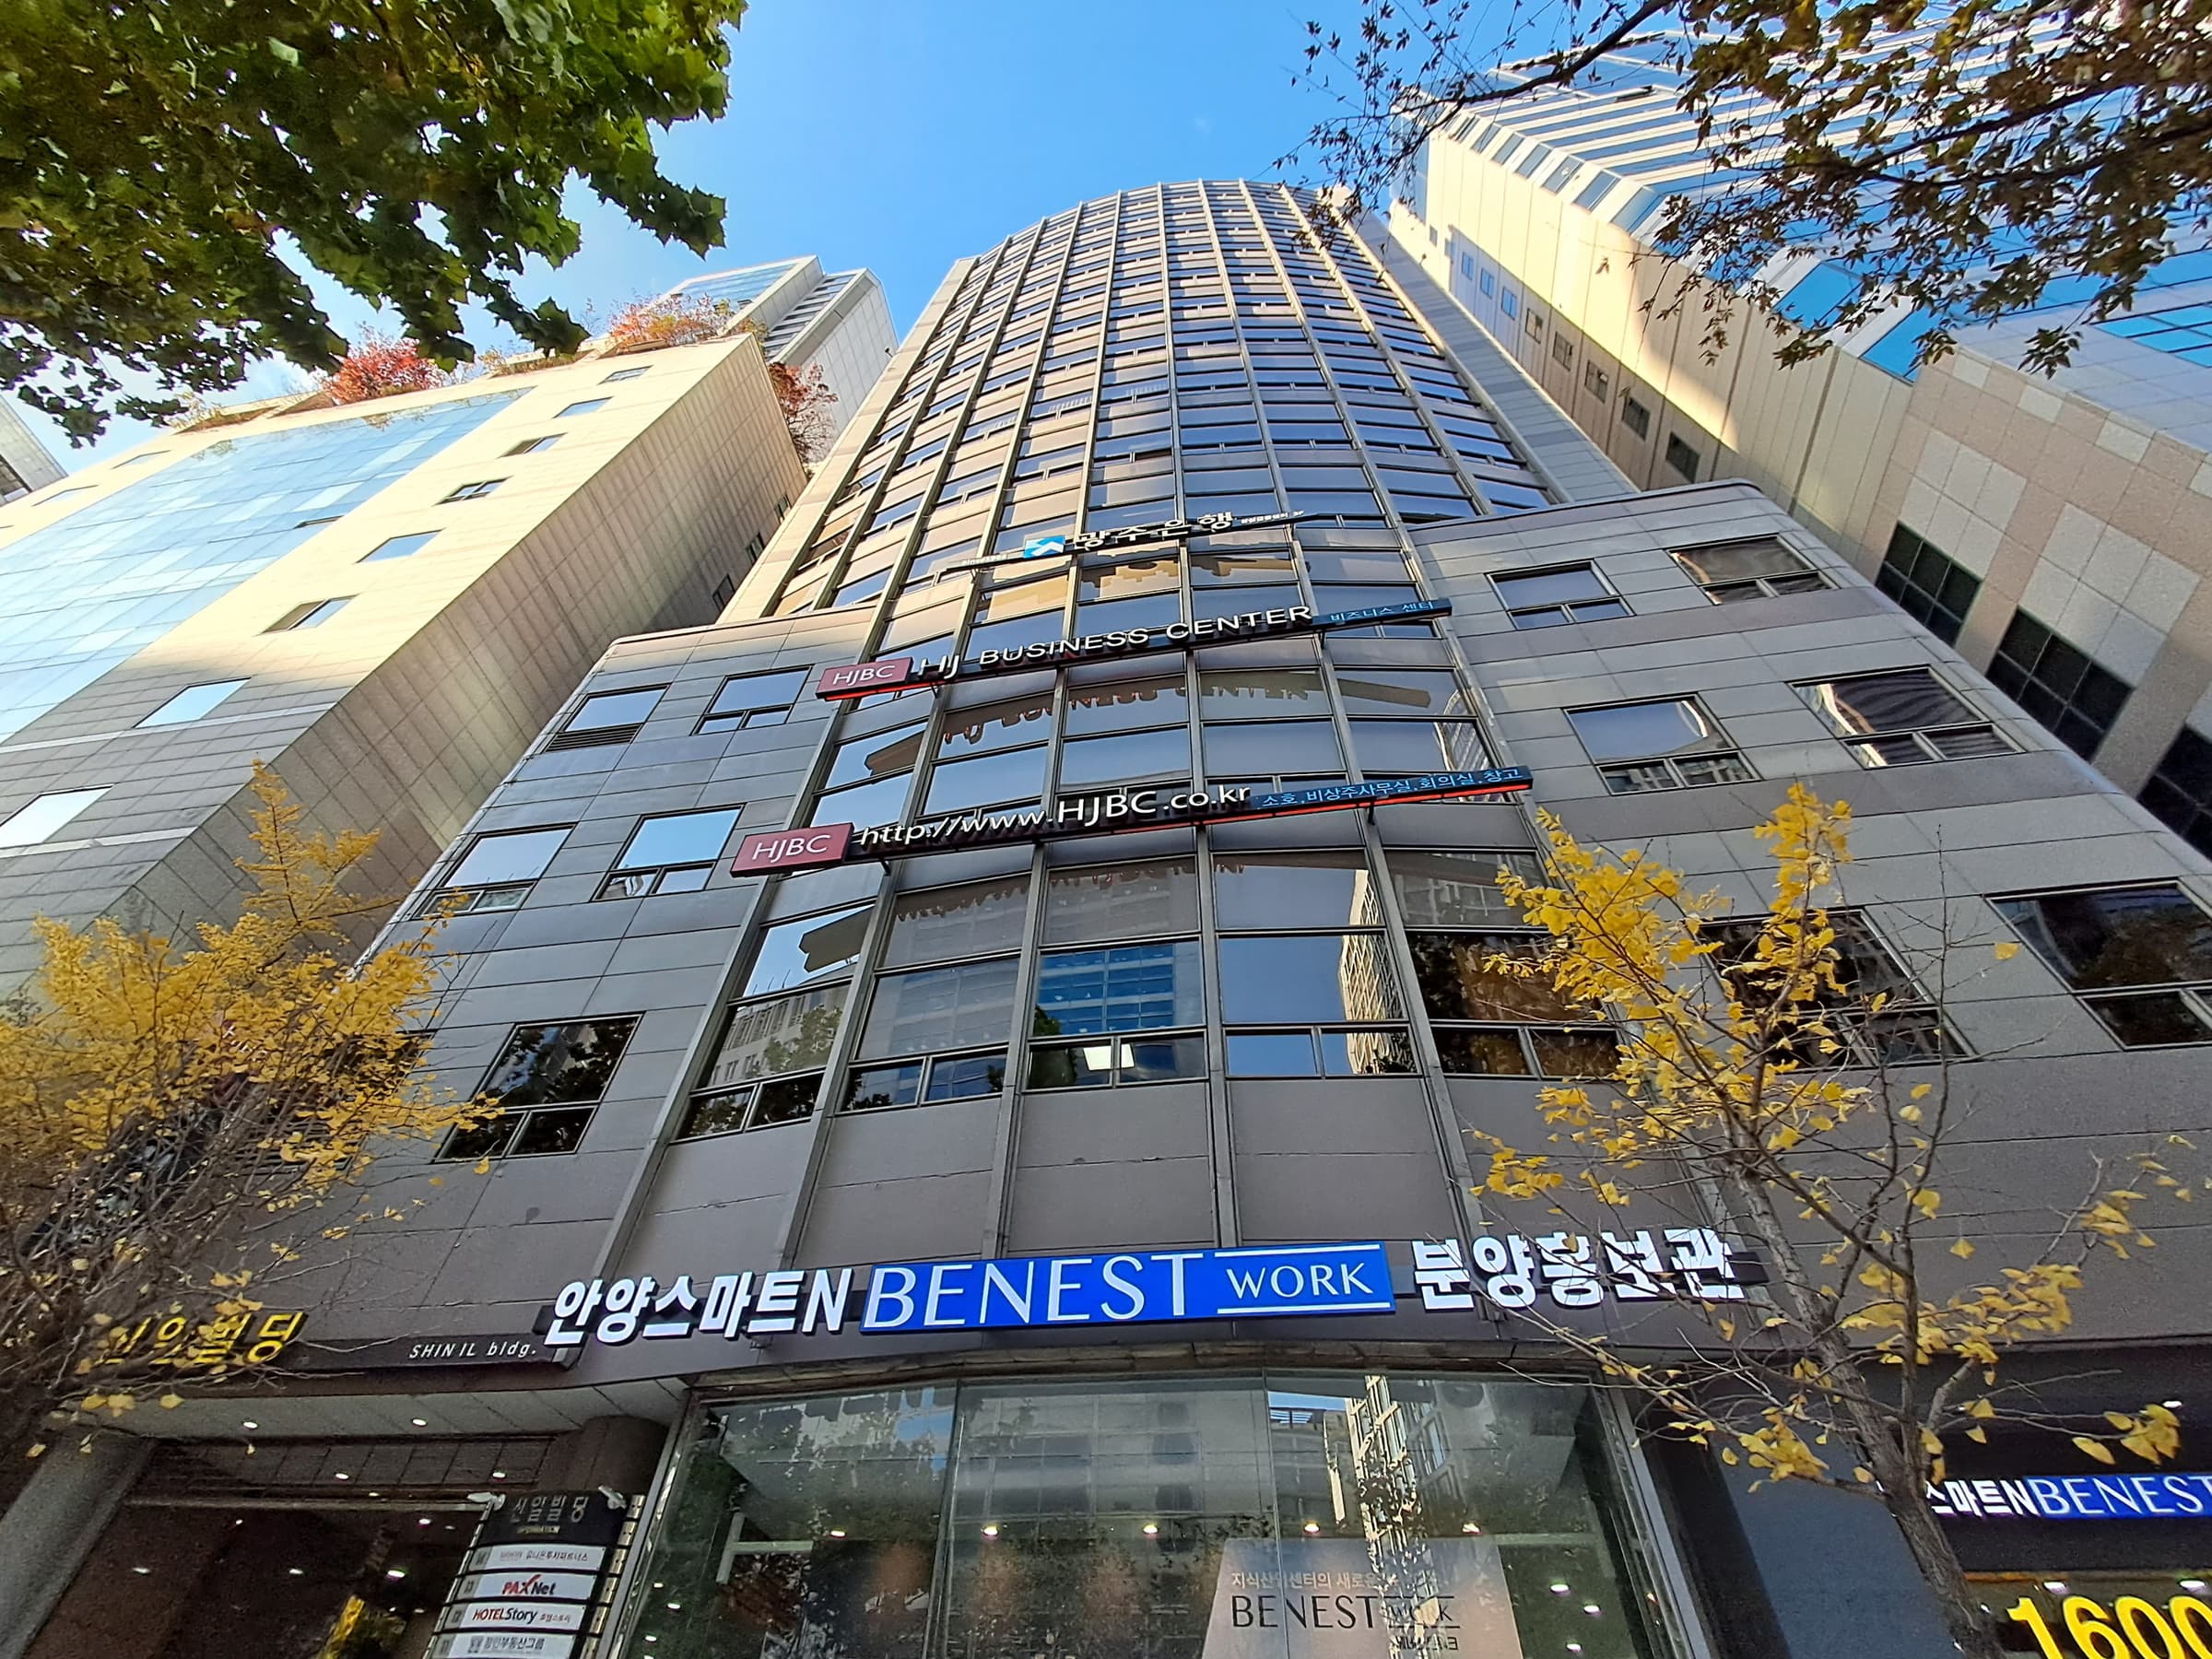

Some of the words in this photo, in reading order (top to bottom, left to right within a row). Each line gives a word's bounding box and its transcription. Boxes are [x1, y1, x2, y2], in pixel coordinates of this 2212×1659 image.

[1074, 512, 1233, 551] 광주은행
[1330, 606, 1394, 621] 비즈니스
[1402, 601, 1433, 612] 센터
[918, 654, 959, 679] HJ
[979, 628, 1149, 665] BUSINESS
[1166, 606, 1312, 641] CENTER
[832, 665, 895, 686] HJBC
[751, 834, 832, 863] HJBC
[1411, 1227, 1746, 1310] 분양홍보관
[542, 1266, 853, 1347] 안양스마트N
[863, 1253, 1204, 1329] BENEST
[1224, 1262, 1374, 1300] WORK
[487, 1341, 537, 1358] bldg.
[510, 1495, 589, 1523] 신일빌딩
[501, 1574, 557, 1595] PAXNet
[1231, 1594, 1379, 1629] BENEST
